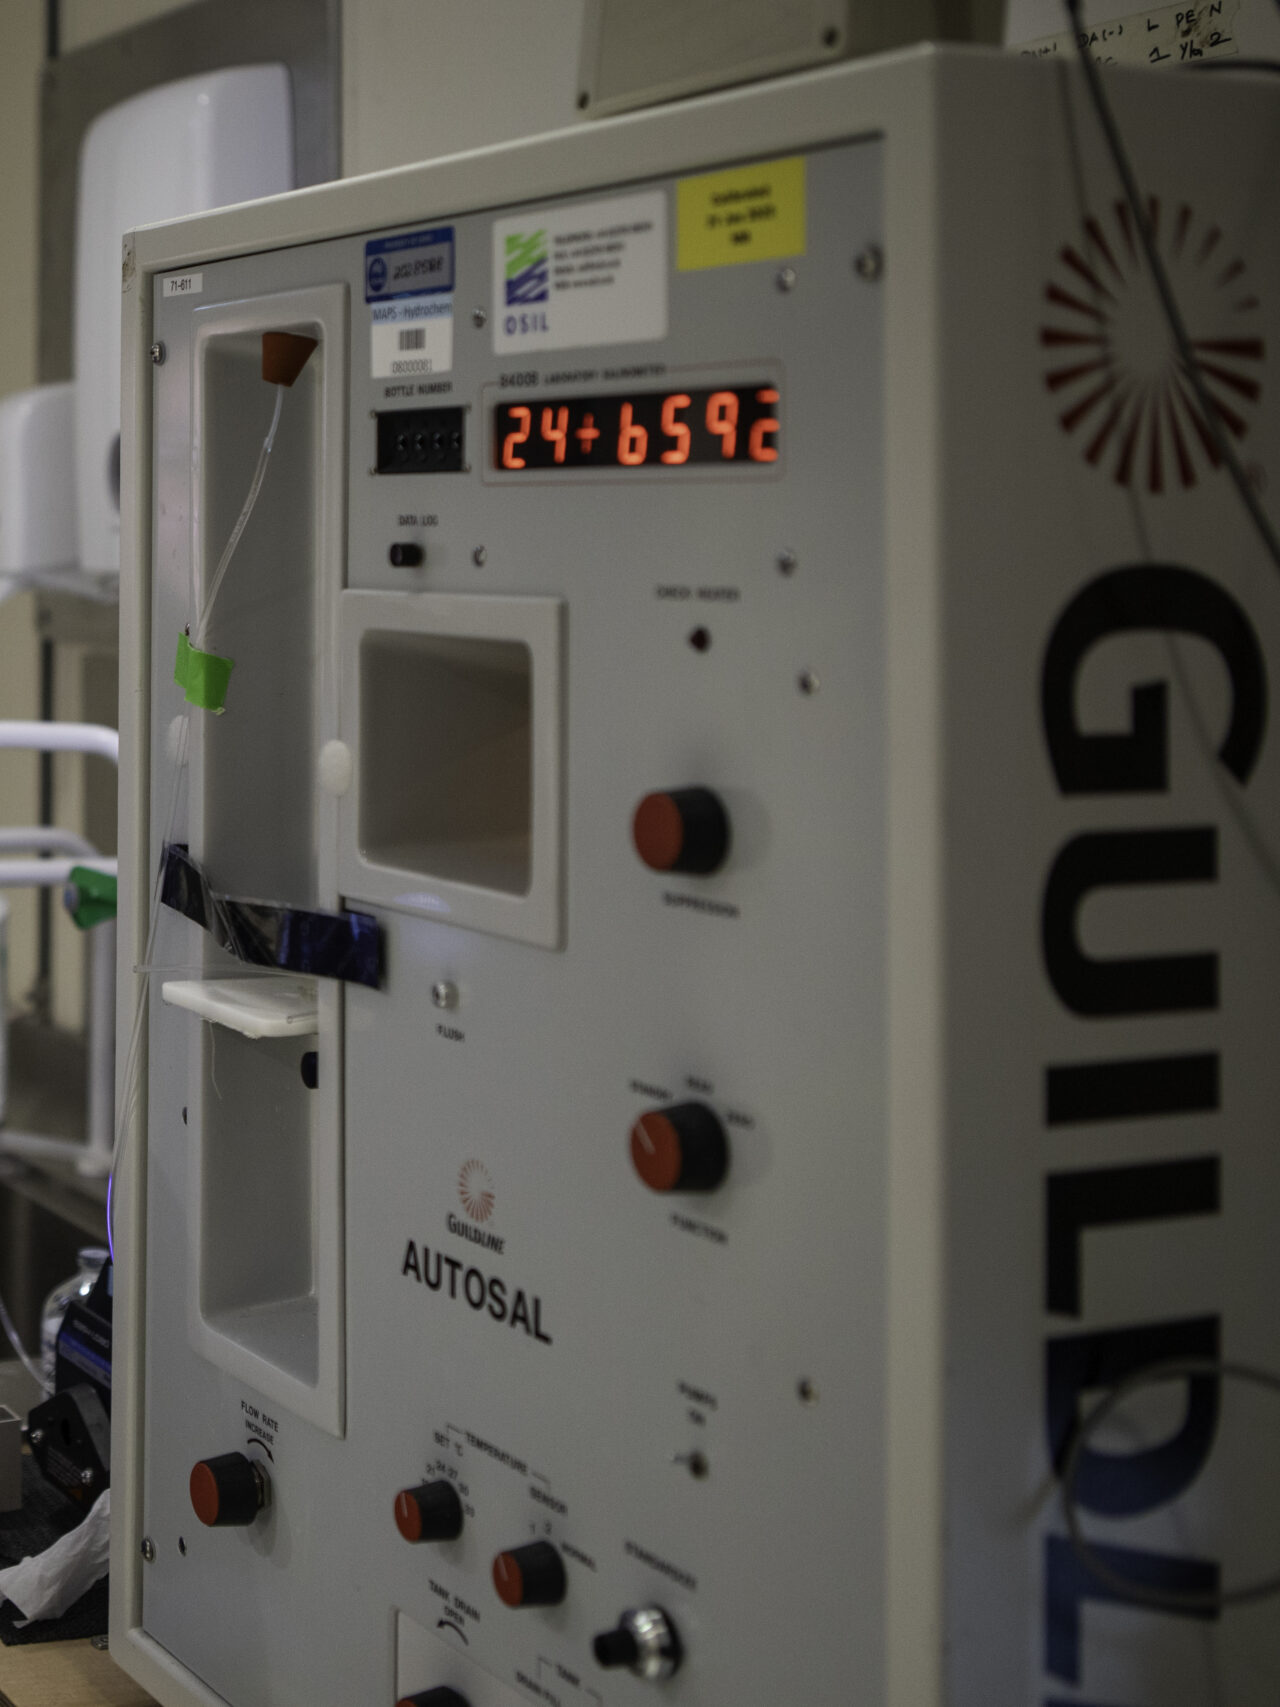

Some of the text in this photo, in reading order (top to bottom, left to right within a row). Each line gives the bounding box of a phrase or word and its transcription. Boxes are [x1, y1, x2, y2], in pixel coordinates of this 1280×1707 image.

[1147, 18, 1160, 32] L
[1209, 0, 1222, 17] N
[1209, 31, 1232, 47] 2
[170, 278, 192, 292] 71-611
[373, 307, 398, 321] MAPS
[404, 302, 452, 321] Hydrochem
[505, 311, 549, 336] OSIL
[384, 381, 454, 399] BOTTLE NUMBER
[399, 513, 439, 527] DATA LOG
[436, 1023, 465, 1043] FLUSH
[1038, 561, 1268, 1707] GUILDL
[447, 1211, 505, 1255] GUILDLINE
[402, 1237, 553, 1346] AUTOSAL
[241, 1400, 279, 1433] FLOW RATE
[245, 1420, 274, 1446] INCREASE
[434, 1431, 450, 1449] SET
[465, 1430, 528, 1477] TEMPERATURE
[428, 1577, 480, 1624] TANK DRAIN
[444, 1605, 465, 1628] OPEN
